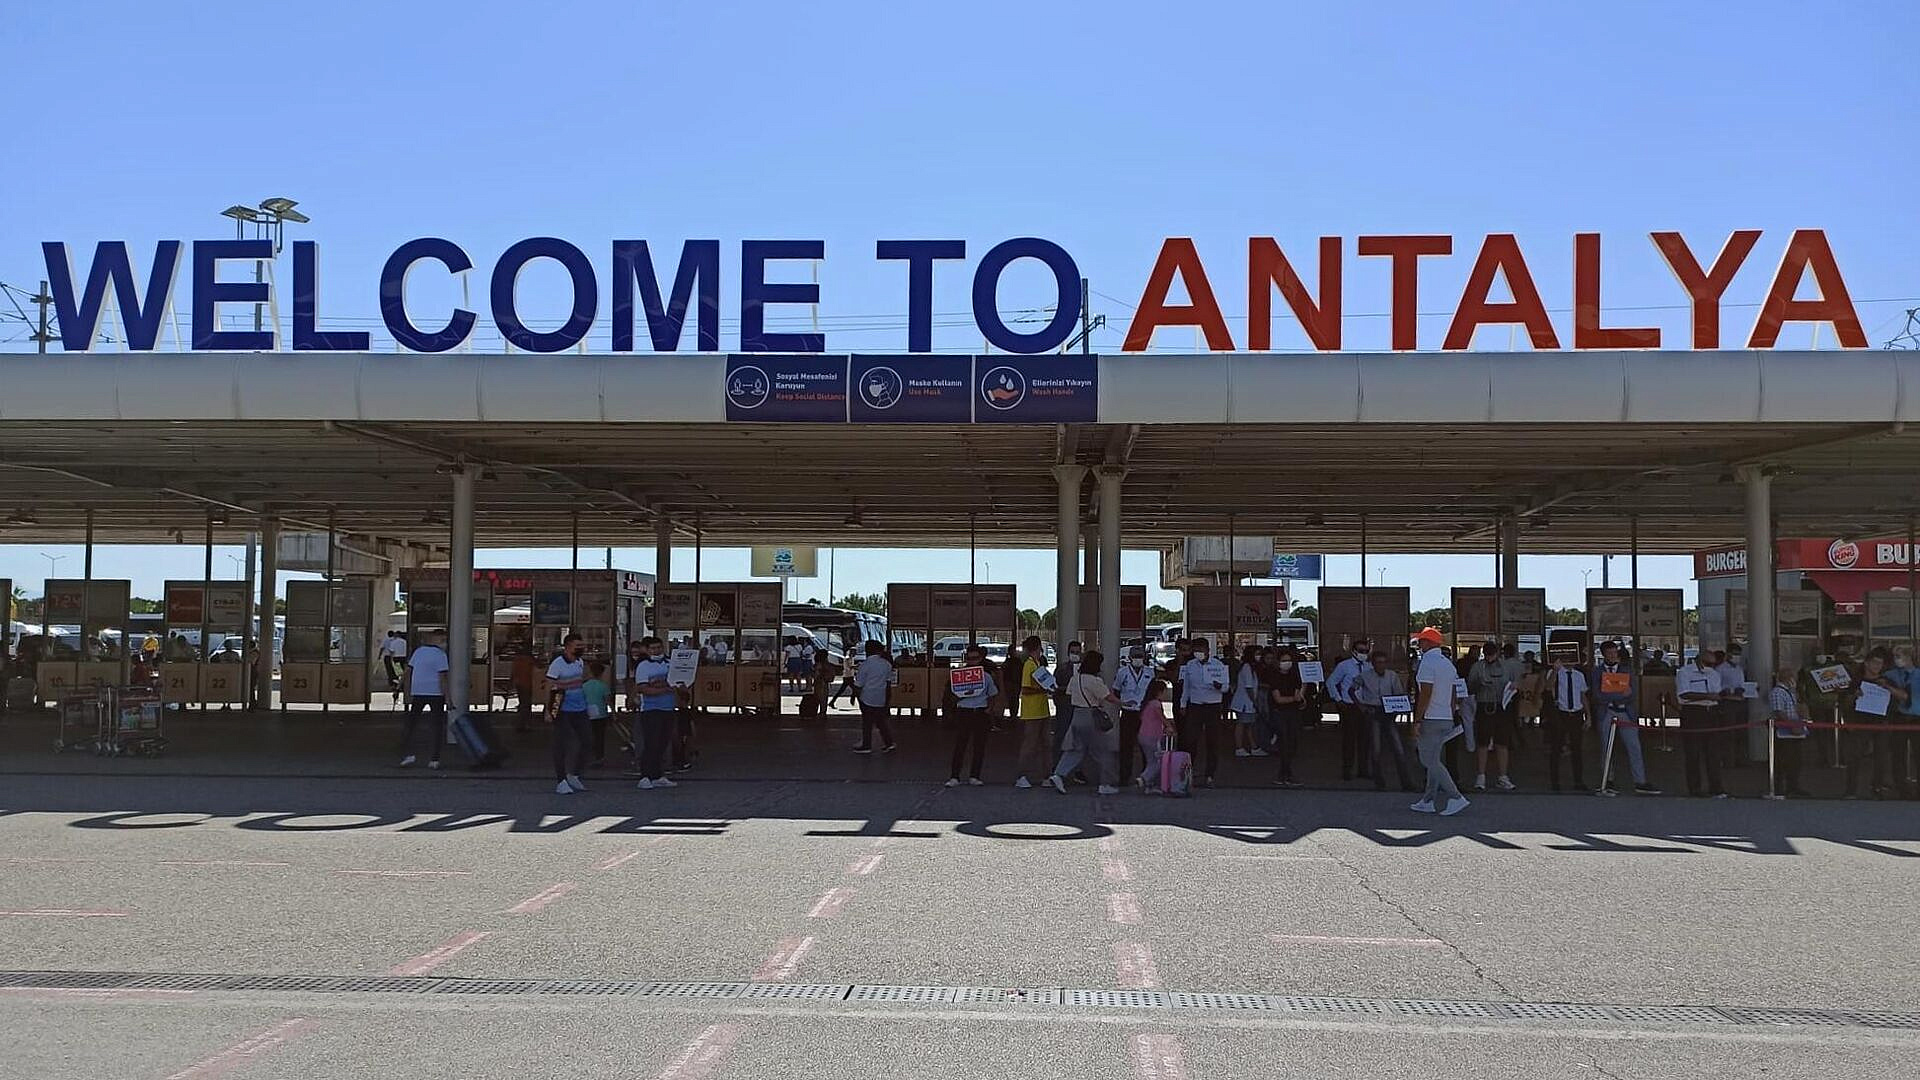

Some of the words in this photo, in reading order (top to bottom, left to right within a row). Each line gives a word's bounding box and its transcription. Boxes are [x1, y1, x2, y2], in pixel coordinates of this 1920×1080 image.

[42, 237, 827, 353] WELCOME
[876, 237, 1083, 354] TO
[1121, 229, 1871, 353] ANTALYA
[776, 373, 799, 381] Sosyal
[1706, 550, 1747, 572] BURGER
[171, 678, 185, 688] 21
[212, 678, 226, 688] 22
[293, 678, 307, 688] 23
[335, 679, 349, 689] 24
[707, 681, 721, 692] 30
[902, 682, 916, 693] 32
